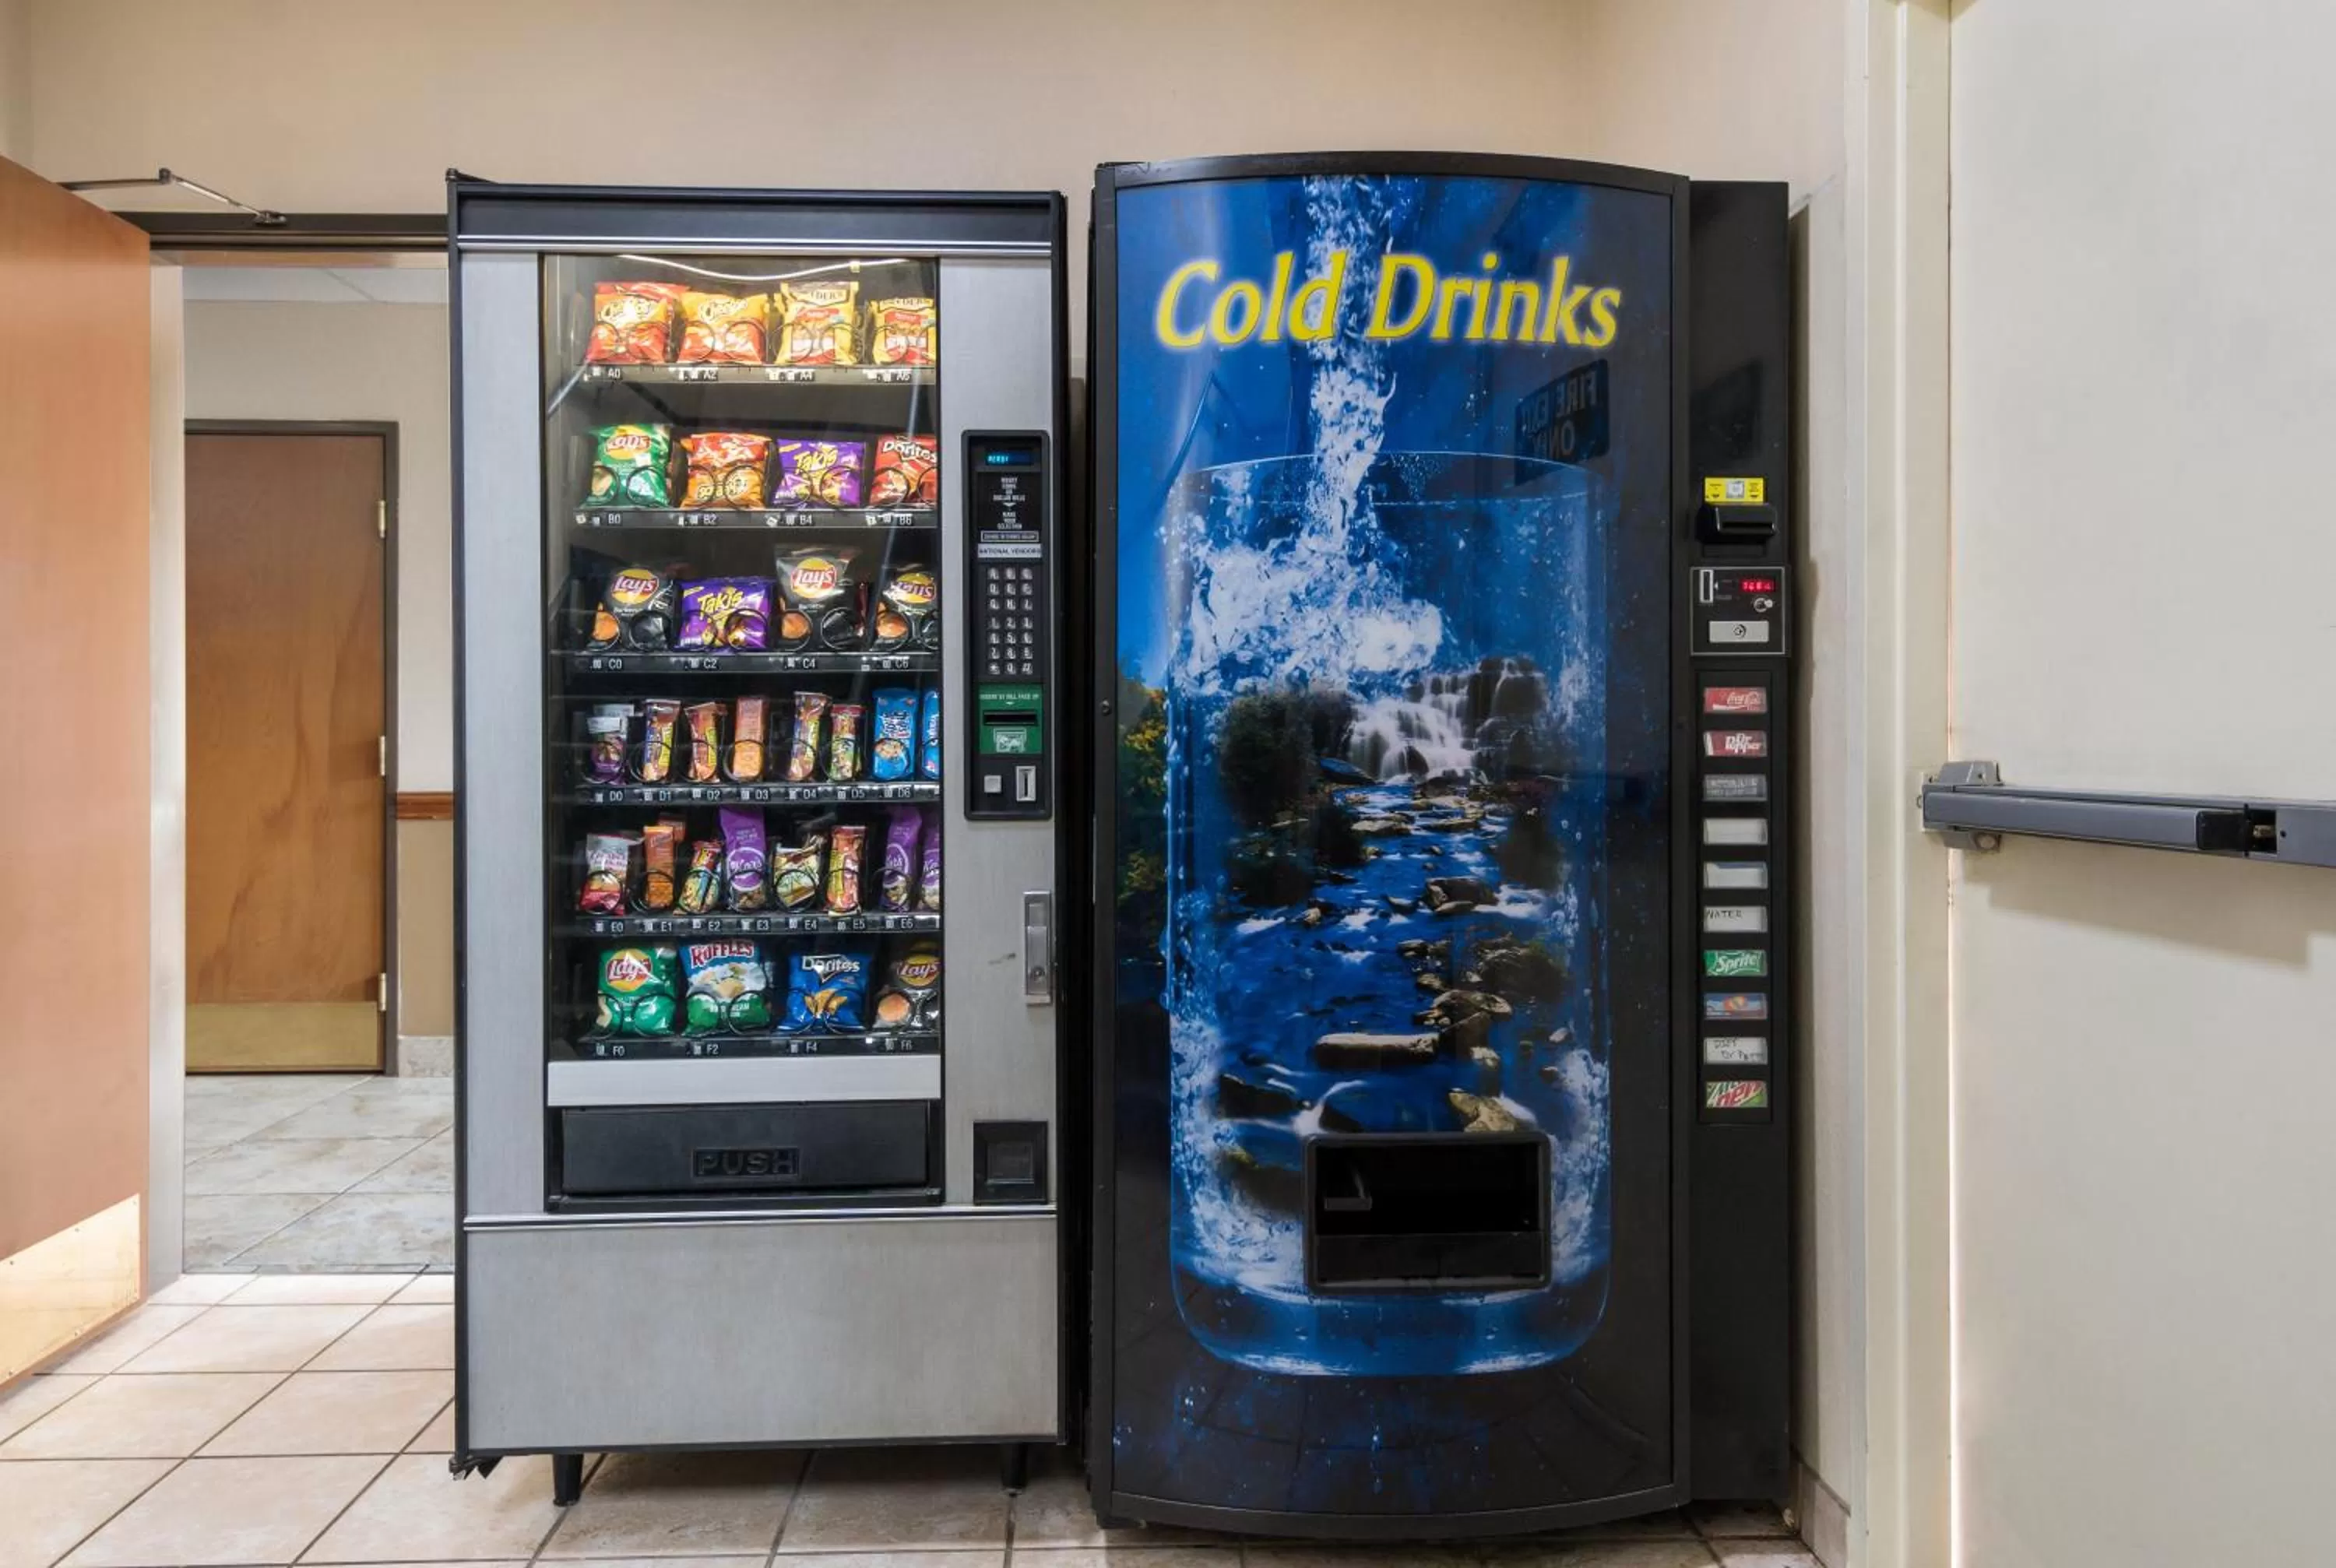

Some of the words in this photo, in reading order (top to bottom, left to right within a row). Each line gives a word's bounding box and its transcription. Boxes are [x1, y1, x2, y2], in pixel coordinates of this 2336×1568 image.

[1157, 251, 1349, 347] Cold
[1364, 252, 1622, 347] Drinks
[883, 441, 938, 462] Doritos
[608, 513, 621, 524] B0
[608, 658, 622, 669] C0
[703, 657, 717, 668] C2
[802, 658, 816, 668] C4
[660, 921, 672, 932] E1
[708, 920, 720, 931] E2
[757, 919, 769, 930] E3
[804, 919, 817, 930] E4
[853, 919, 865, 930] E5
[802, 956, 860, 973] Doritos
[1715, 953, 1757, 973] Sprite
[706, 1044, 719, 1055] F2
[698, 1151, 793, 1176] PUSH
